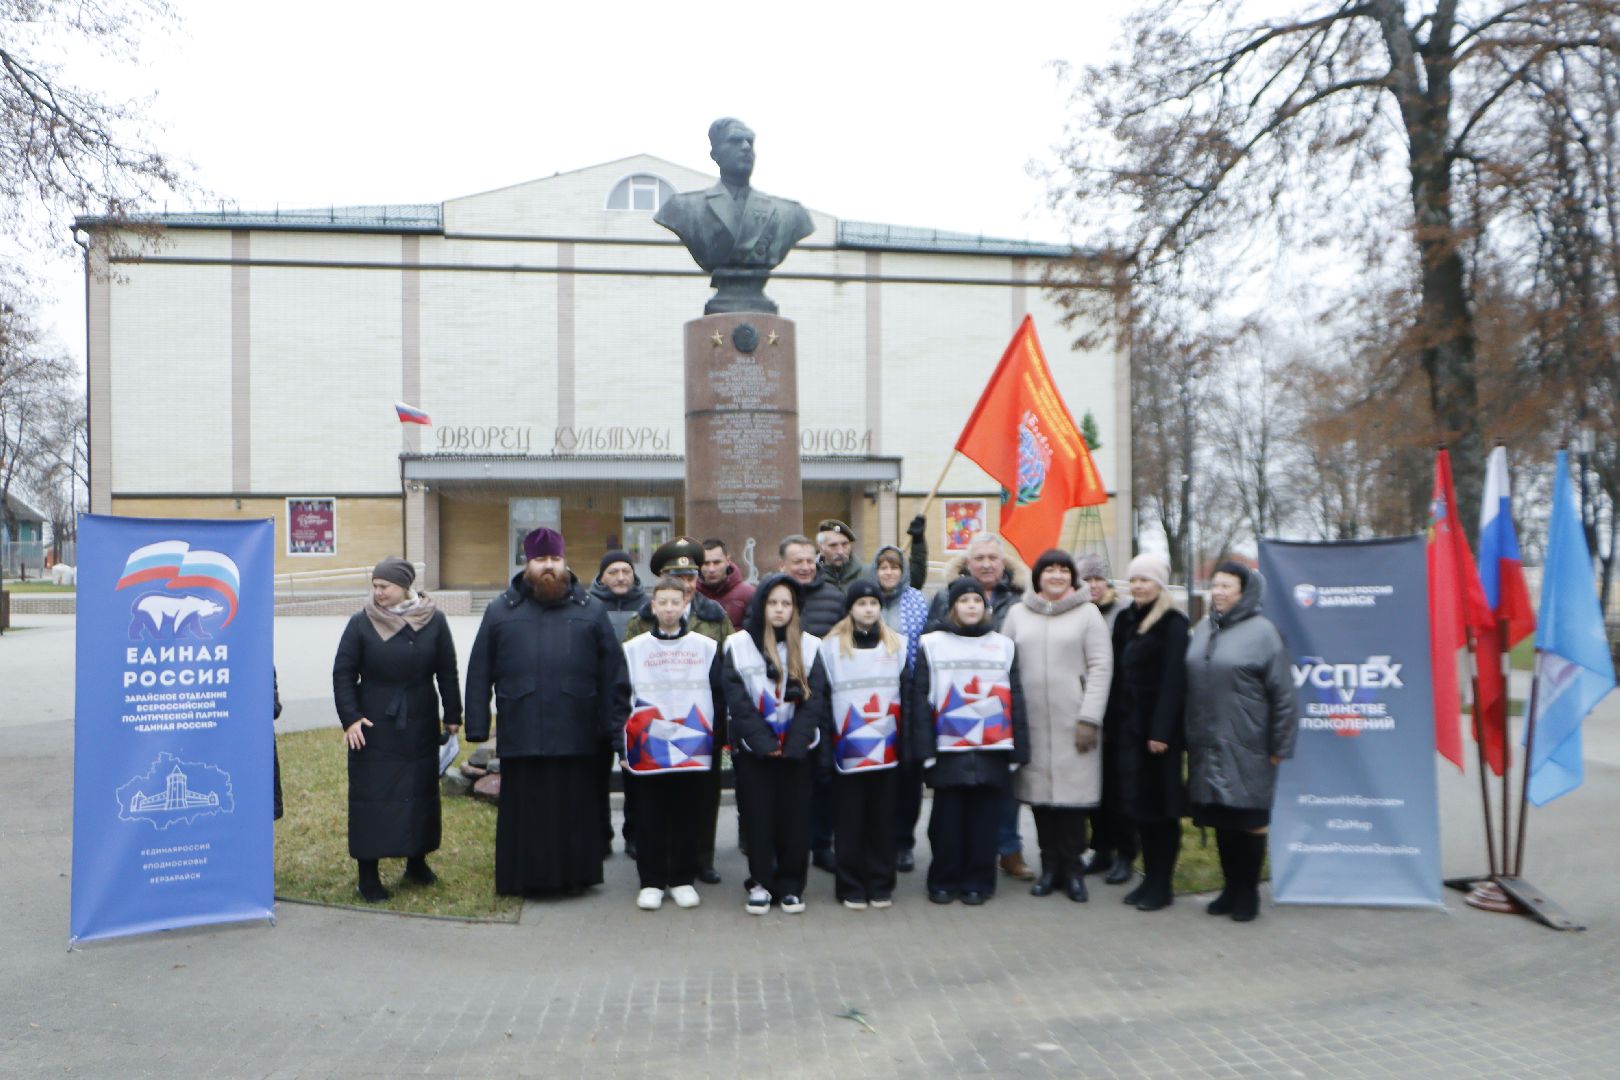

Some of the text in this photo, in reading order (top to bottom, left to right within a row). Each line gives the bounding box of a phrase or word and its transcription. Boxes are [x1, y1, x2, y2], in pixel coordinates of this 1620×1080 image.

[126, 645, 228, 665] ЕДИНАЯ
[123, 668, 230, 688] РОССИЯ
[1291, 664, 1403, 688] УСПЕХ
[125, 691, 227, 703] ЗАРАЙСКОЕ ОТДЕЛЕНИЕ
[136, 701, 216, 712] ВСЕРОССИЙСКОЙ
[1308, 703, 1386, 714] ЕДИНСТВЕ
[122, 711, 194, 722] ПОЛИТИЧЕСКОЙ
[1299, 717, 1395, 730] ПОКОЛЕНИЙ
